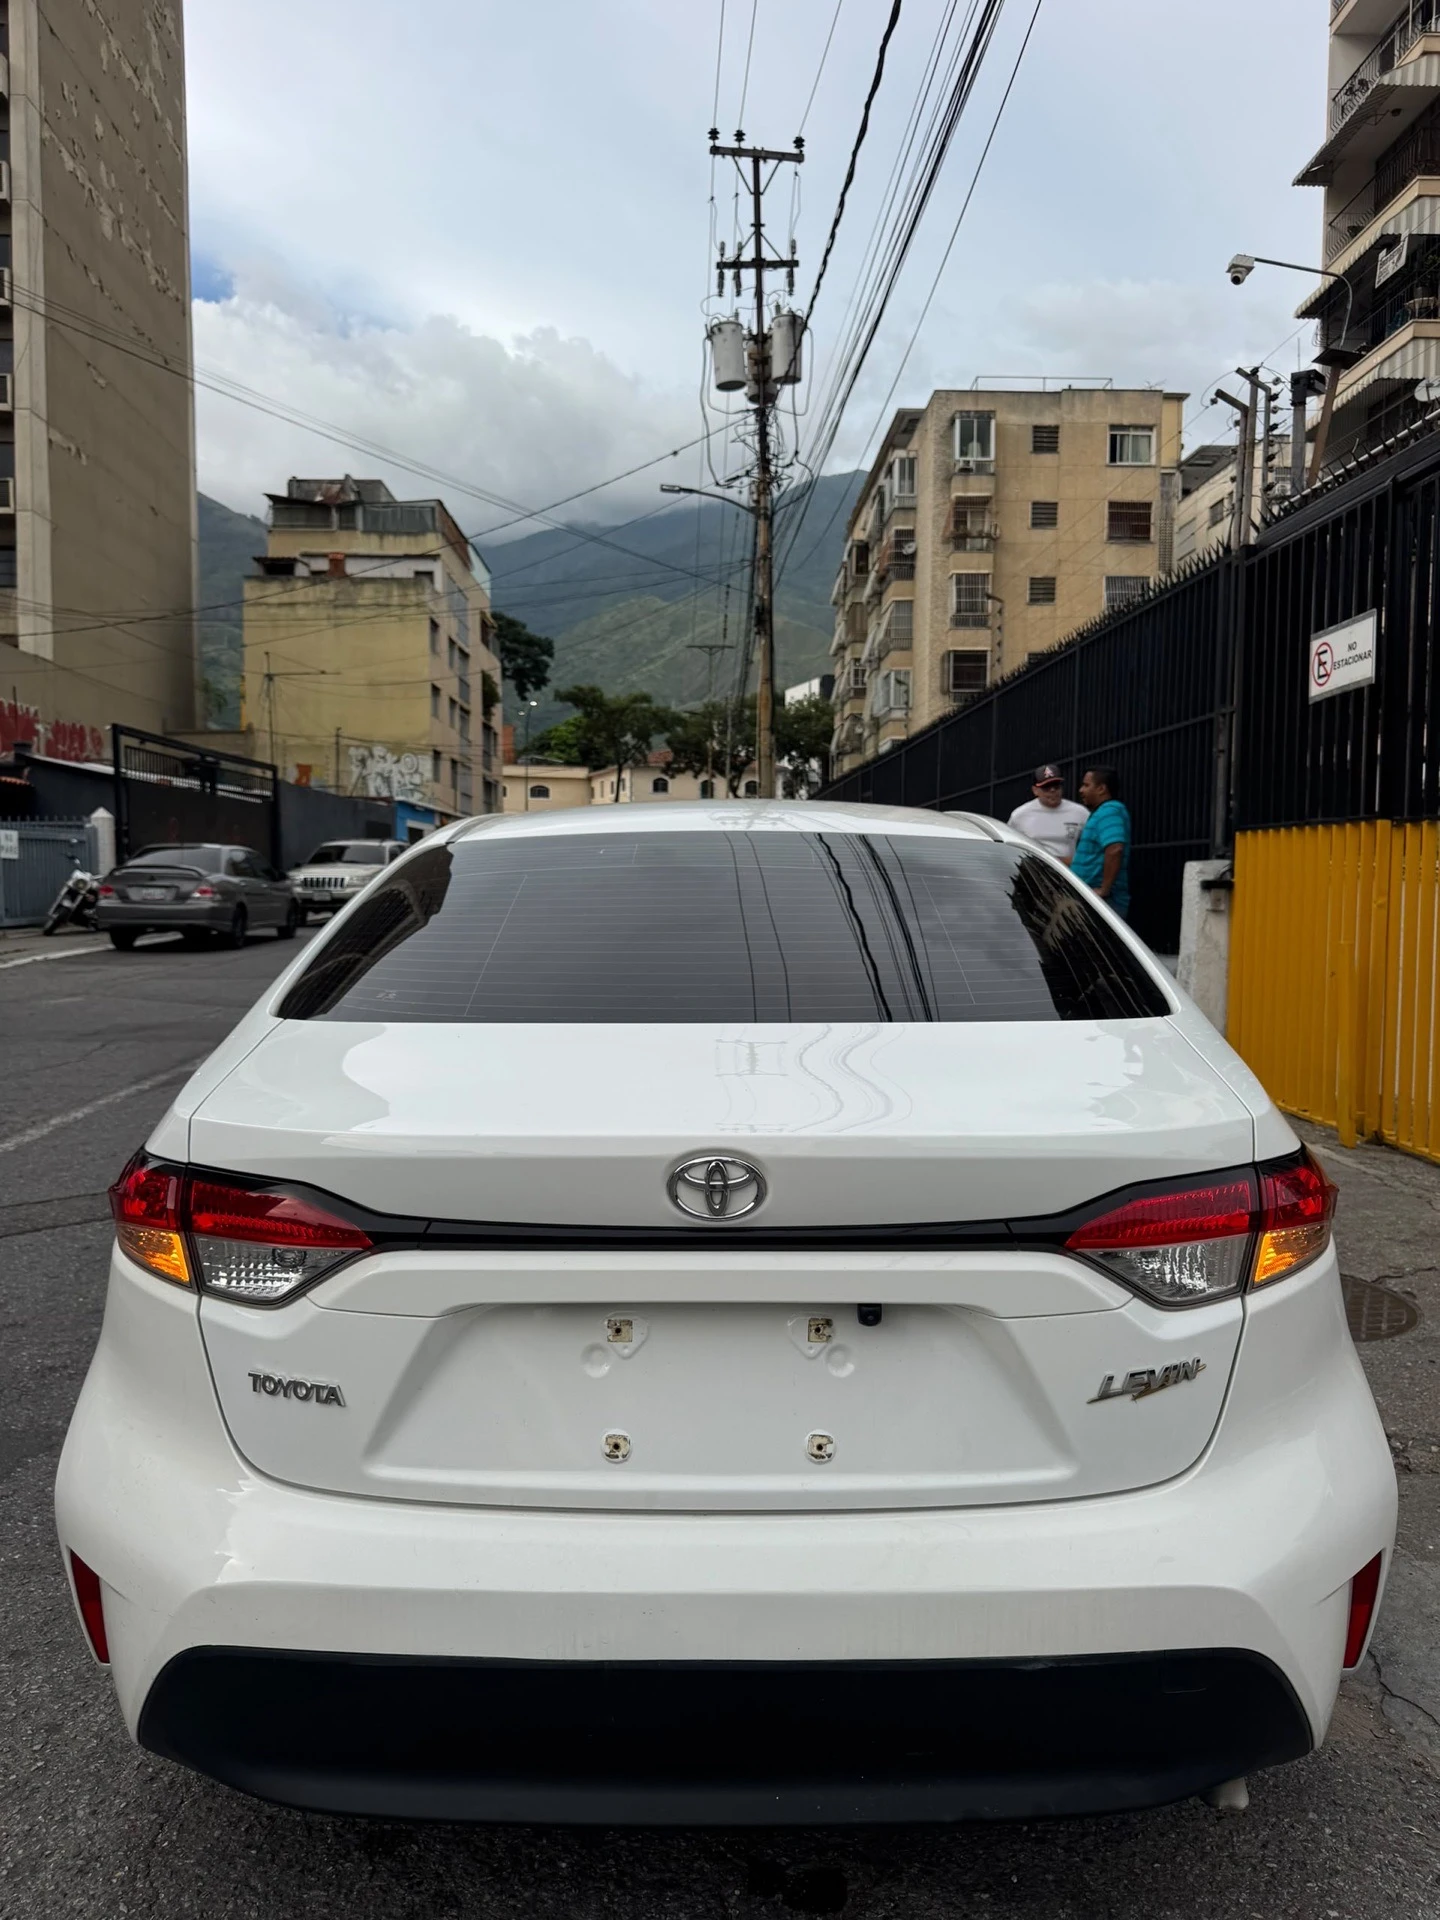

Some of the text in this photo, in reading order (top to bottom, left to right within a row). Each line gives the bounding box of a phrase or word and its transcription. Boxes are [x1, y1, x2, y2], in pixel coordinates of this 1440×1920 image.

[1333, 649, 1373, 671] ESTACIONAR
[1347, 641, 1358, 652] NO
[247, 1370, 346, 1407] TOYOTA
[1097, 1357, 1202, 1400] LEVIN
